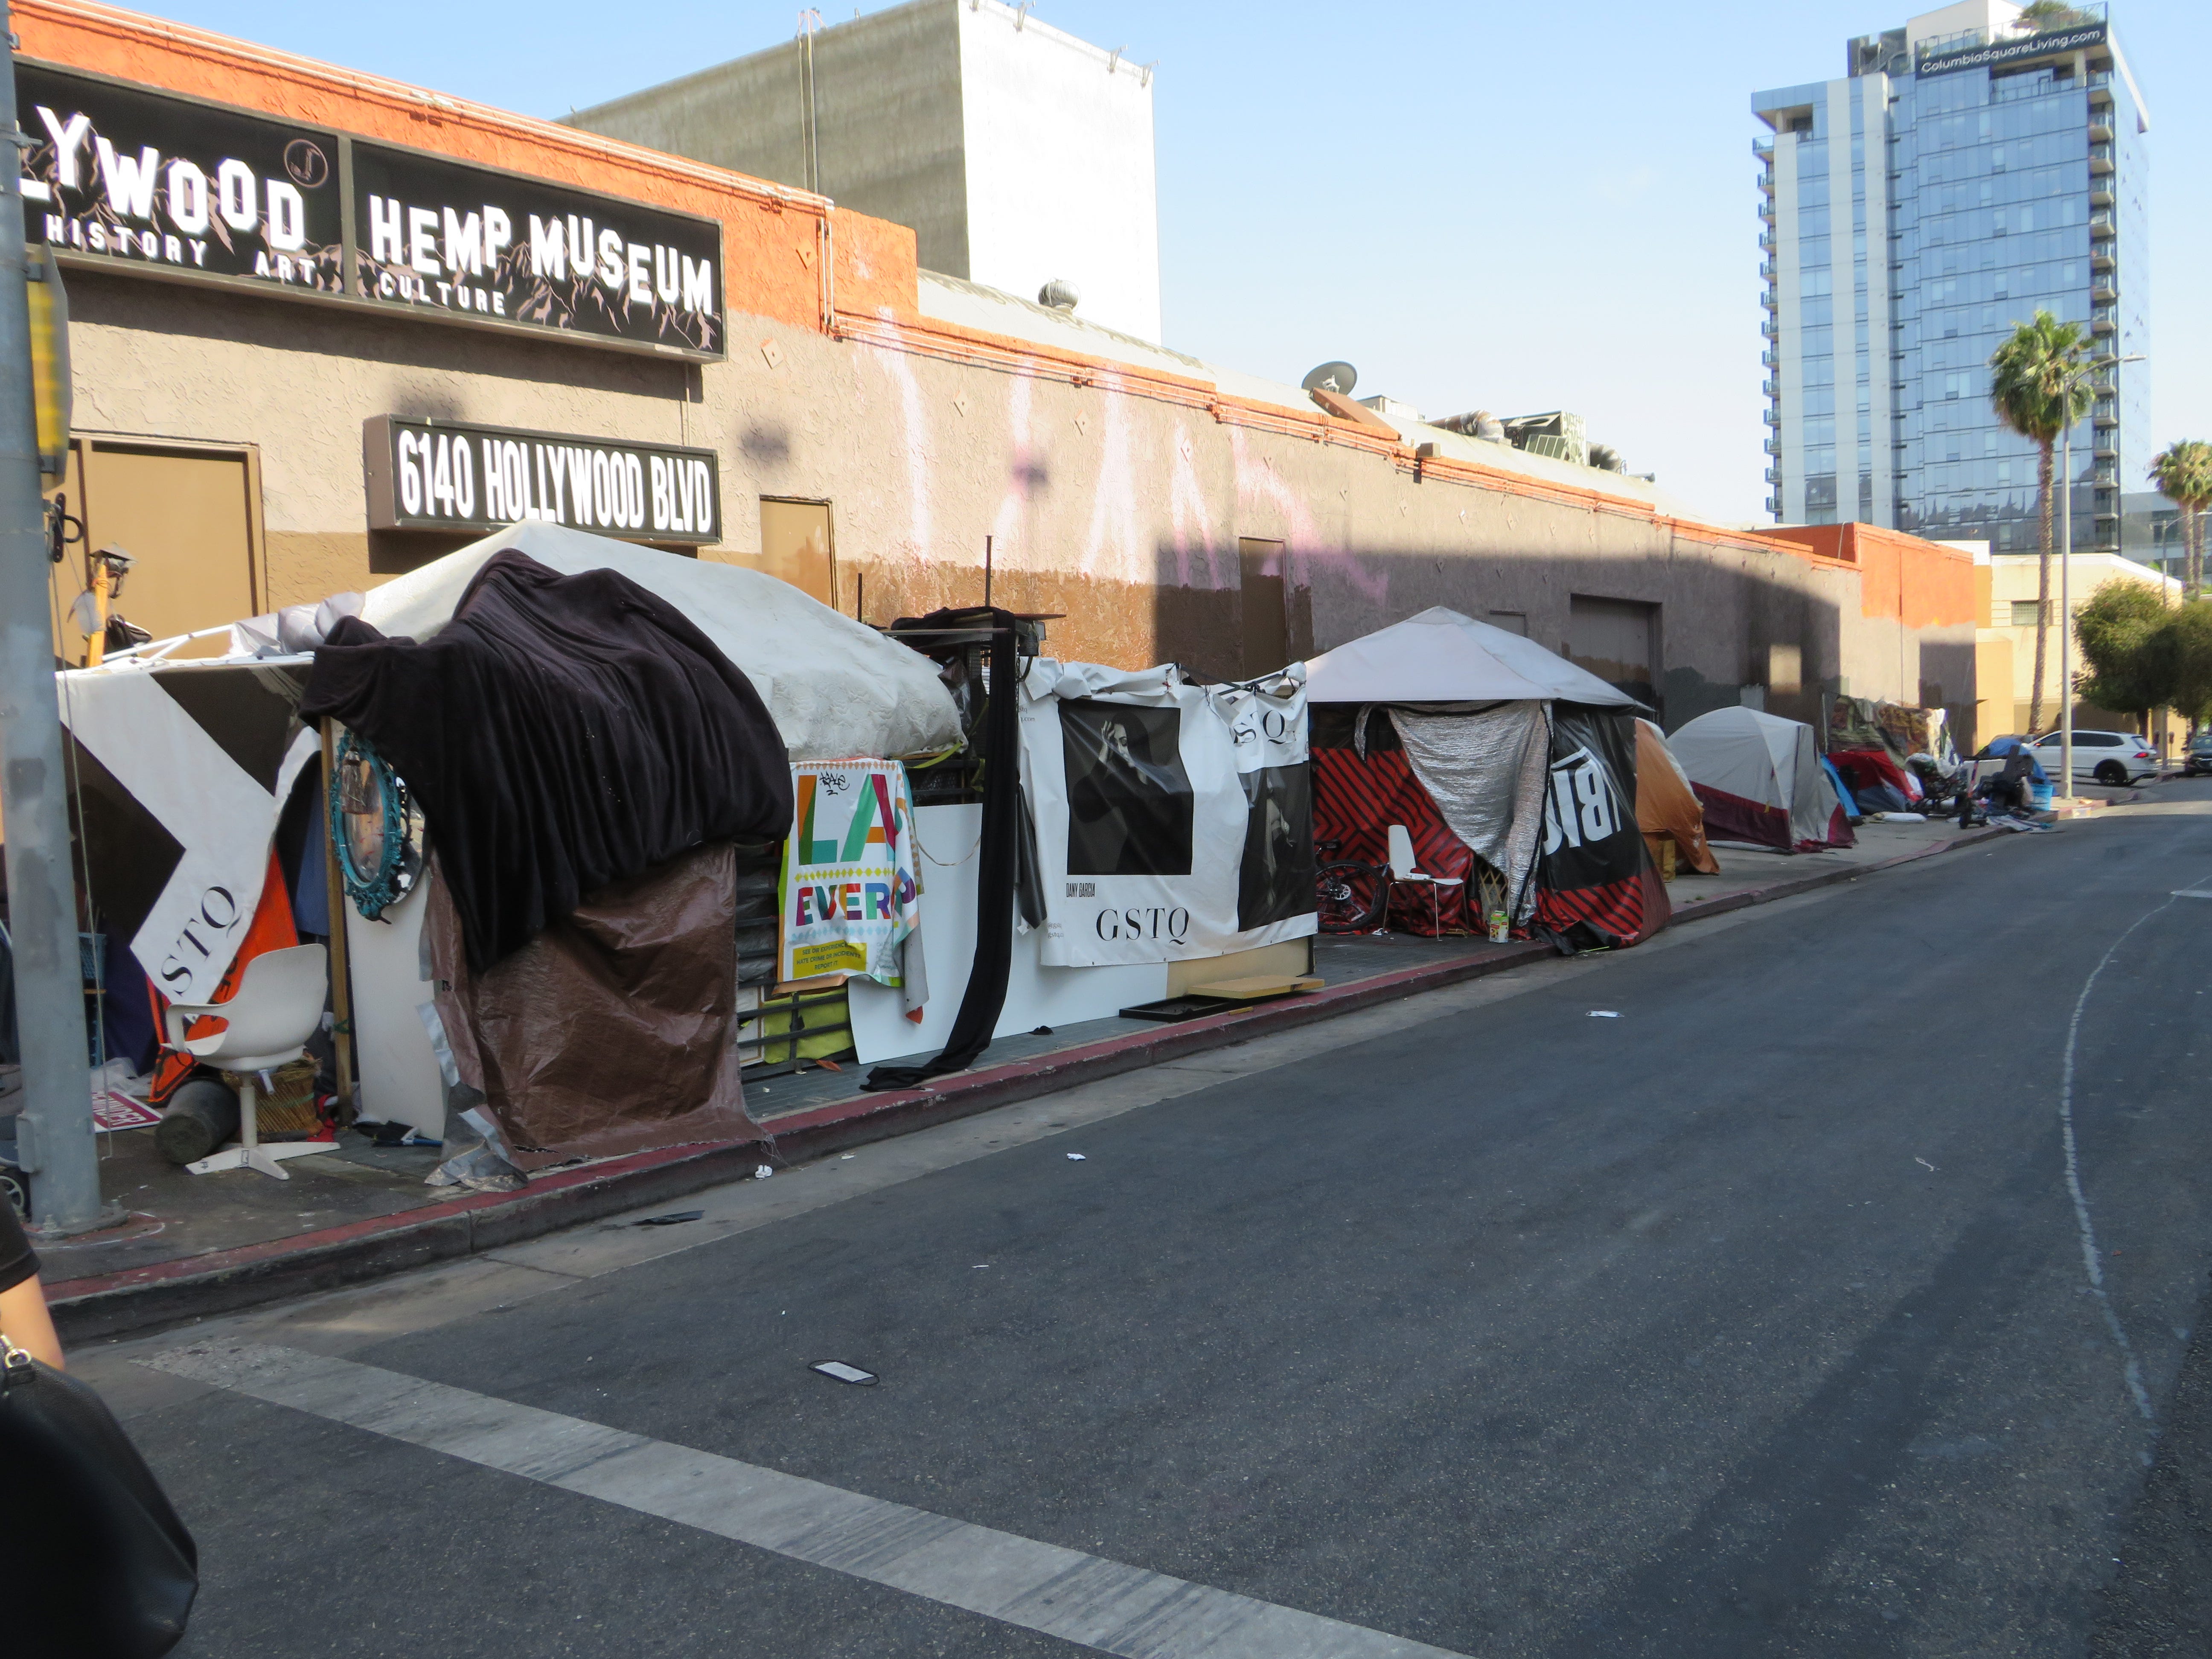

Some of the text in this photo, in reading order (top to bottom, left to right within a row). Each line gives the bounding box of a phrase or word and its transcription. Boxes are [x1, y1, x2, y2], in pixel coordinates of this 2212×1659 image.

[1921, 29, 2100, 72] ColumbiaSquareLiving.com
[45, 213, 505, 316] HISTORY ART CULTURE
[369, 194, 512, 277] HEMP
[529, 213, 713, 316] MUSEUM
[398, 428, 712, 533] 6140 HOLLYWOOD BLVD
[1066, 883, 1095, 897] DANY GARCIA
[1096, 907, 1189, 945] GSTQ
[815, 961, 832, 969] REPORT
